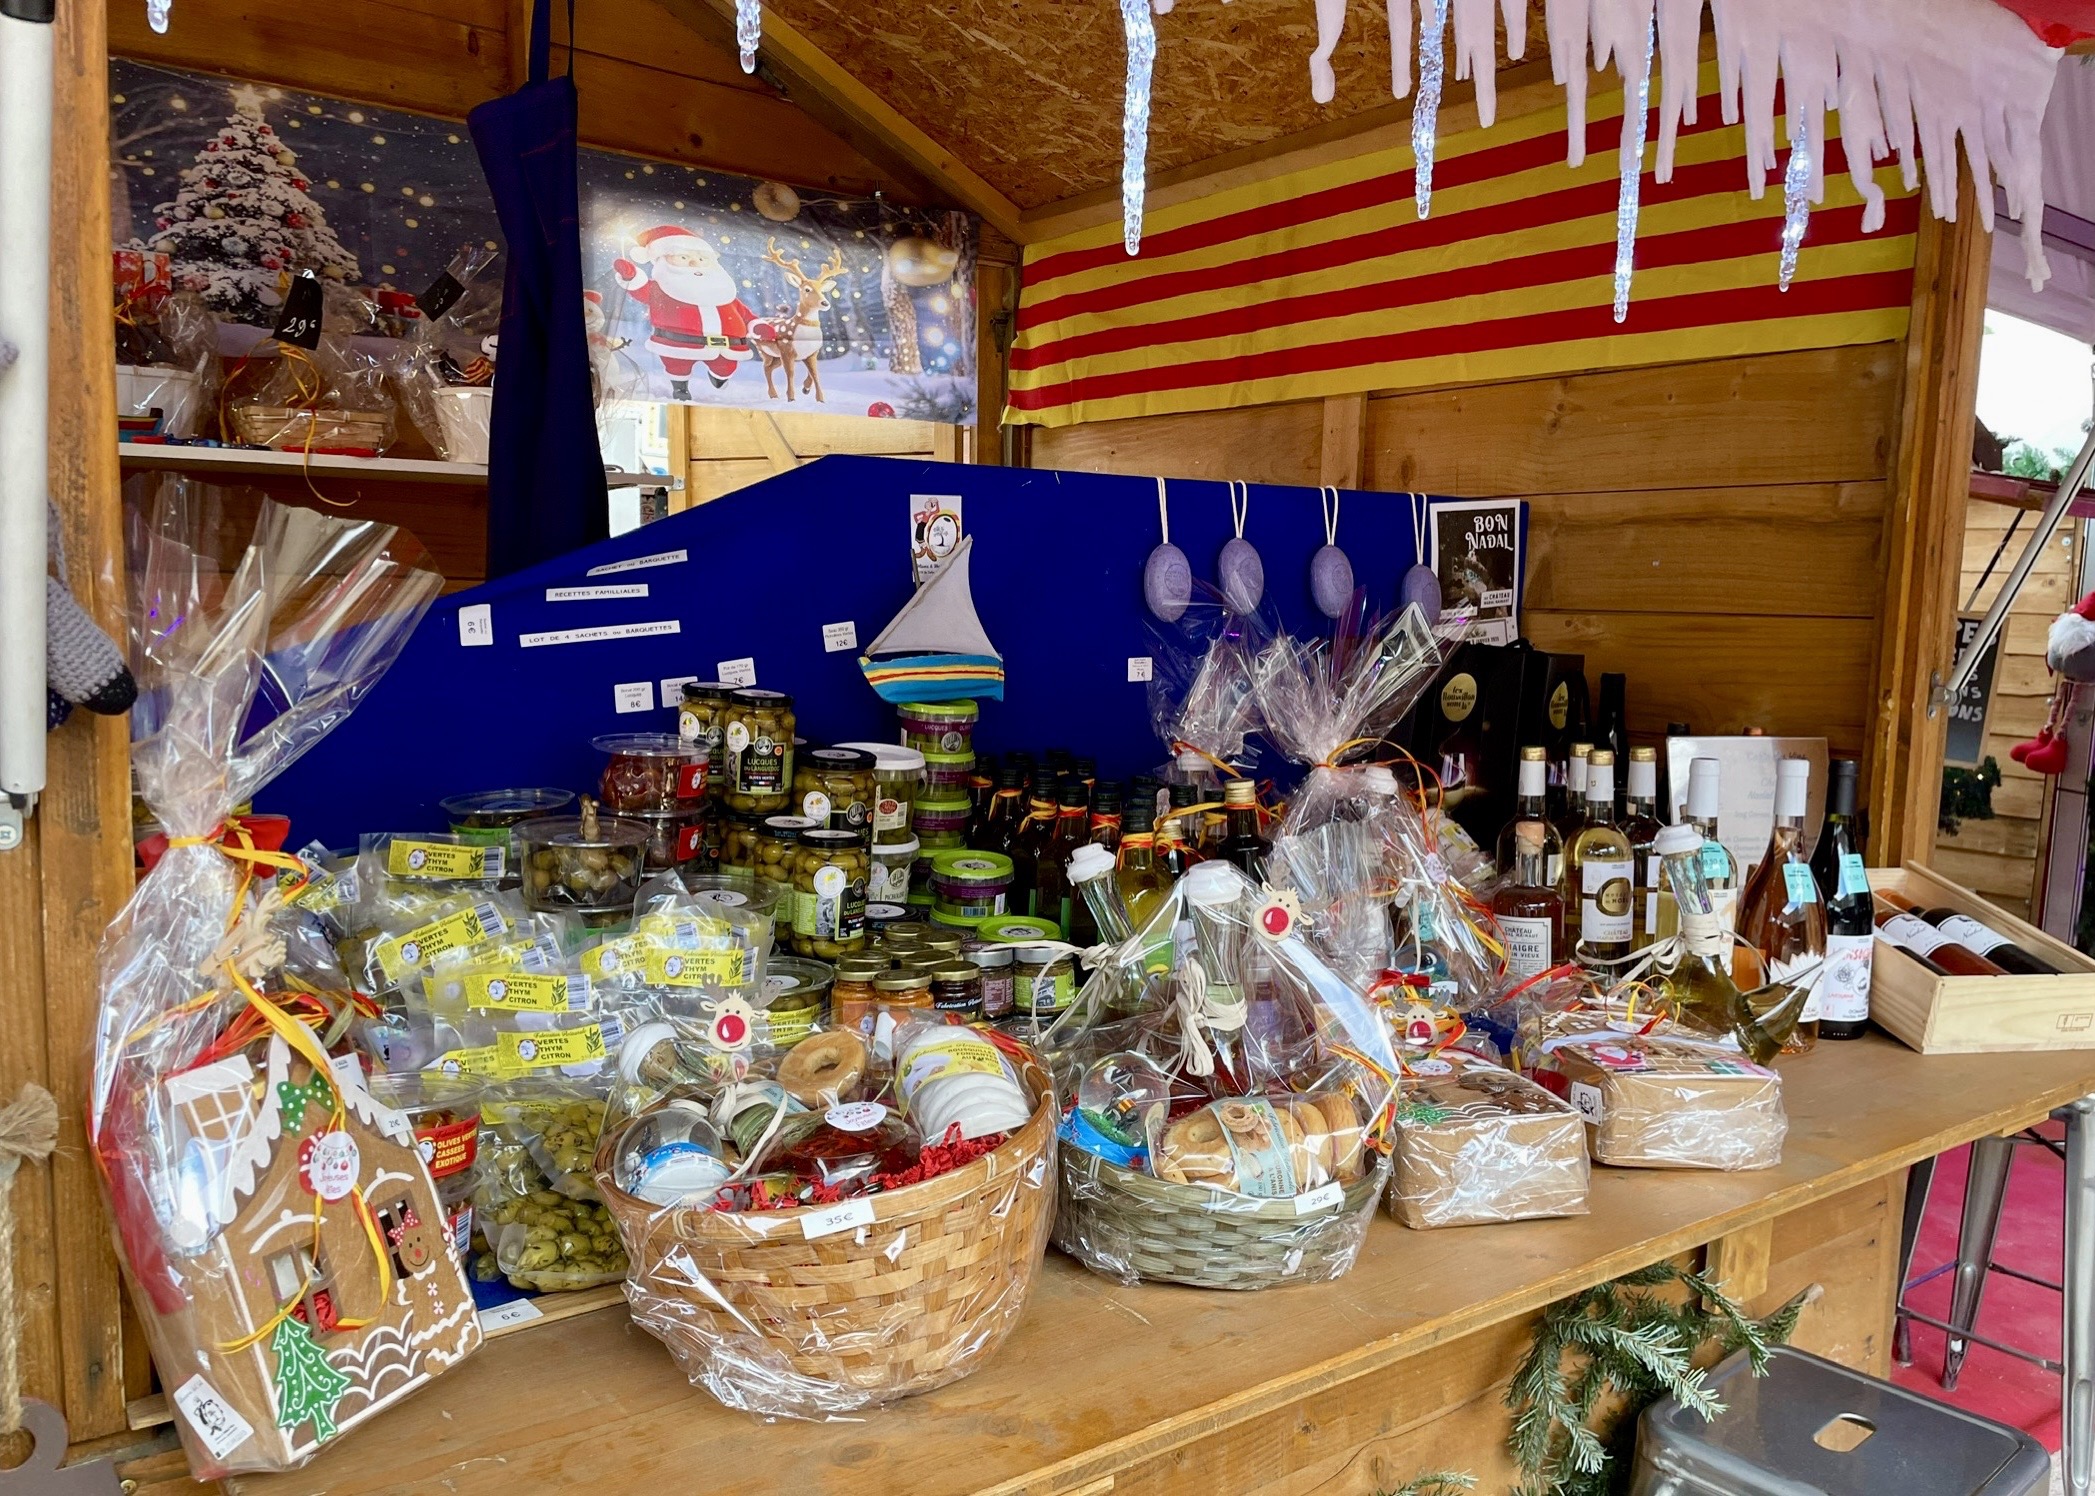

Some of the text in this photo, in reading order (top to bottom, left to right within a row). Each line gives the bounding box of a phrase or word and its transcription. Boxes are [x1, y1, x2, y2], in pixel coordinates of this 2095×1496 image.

[1474, 514, 1508, 532] BON
[1465, 531, 1514, 551] NADAL
[639, 554, 680, 565] BARQUETTE
[554, 587, 641, 598] RECETTES FAMILLIALES
[575, 631, 608, 639] SACHETS
[626, 624, 673, 635] BARQUETTES
[747, 758, 778, 766] LUCQUES
[428, 851, 456, 859] VERTES
[419, 928, 449, 944] VERTES
[422, 939, 444, 952] THYM
[424, 942, 454, 958] CITRON
[508, 981, 538, 989] VERTES
[509, 996, 537, 1004] CITRON
[537, 1038, 569, 1046] VERTES
[540, 1045, 563, 1053] THYM
[541, 1052, 571, 1060] CITRON
[437, 1136, 461, 1149] OLIVES
[435, 1152, 467, 1168] EXOTIQUE
[1311, 1192, 1330, 1206] 29€
[825, 1212, 854, 1226] 35€
